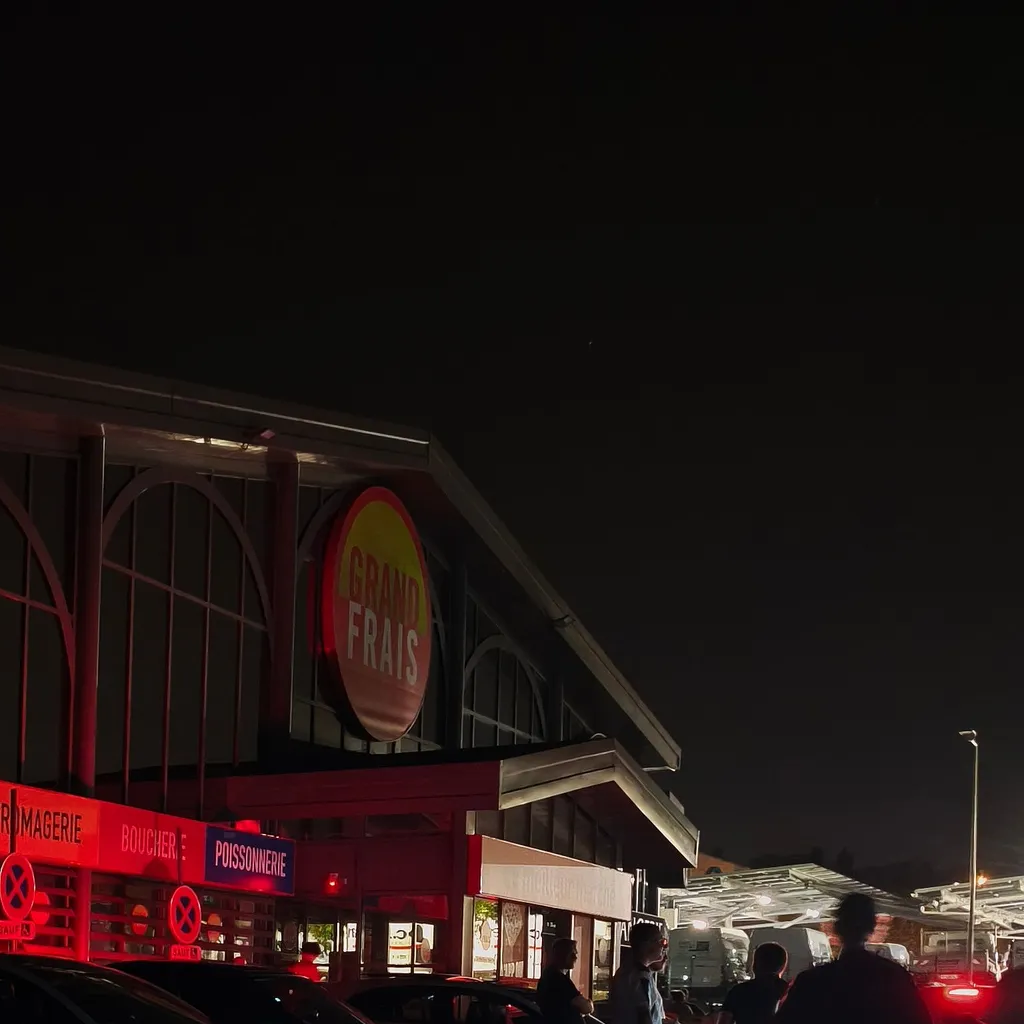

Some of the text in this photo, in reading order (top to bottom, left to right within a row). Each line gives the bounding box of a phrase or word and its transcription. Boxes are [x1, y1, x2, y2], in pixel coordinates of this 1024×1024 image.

[349, 545, 420, 627] GRAND
[347, 600, 419, 686] FRAIS
[121, 824, 187, 861] BOUCHERE
[215, 840, 287, 877] POISSONNERIE
